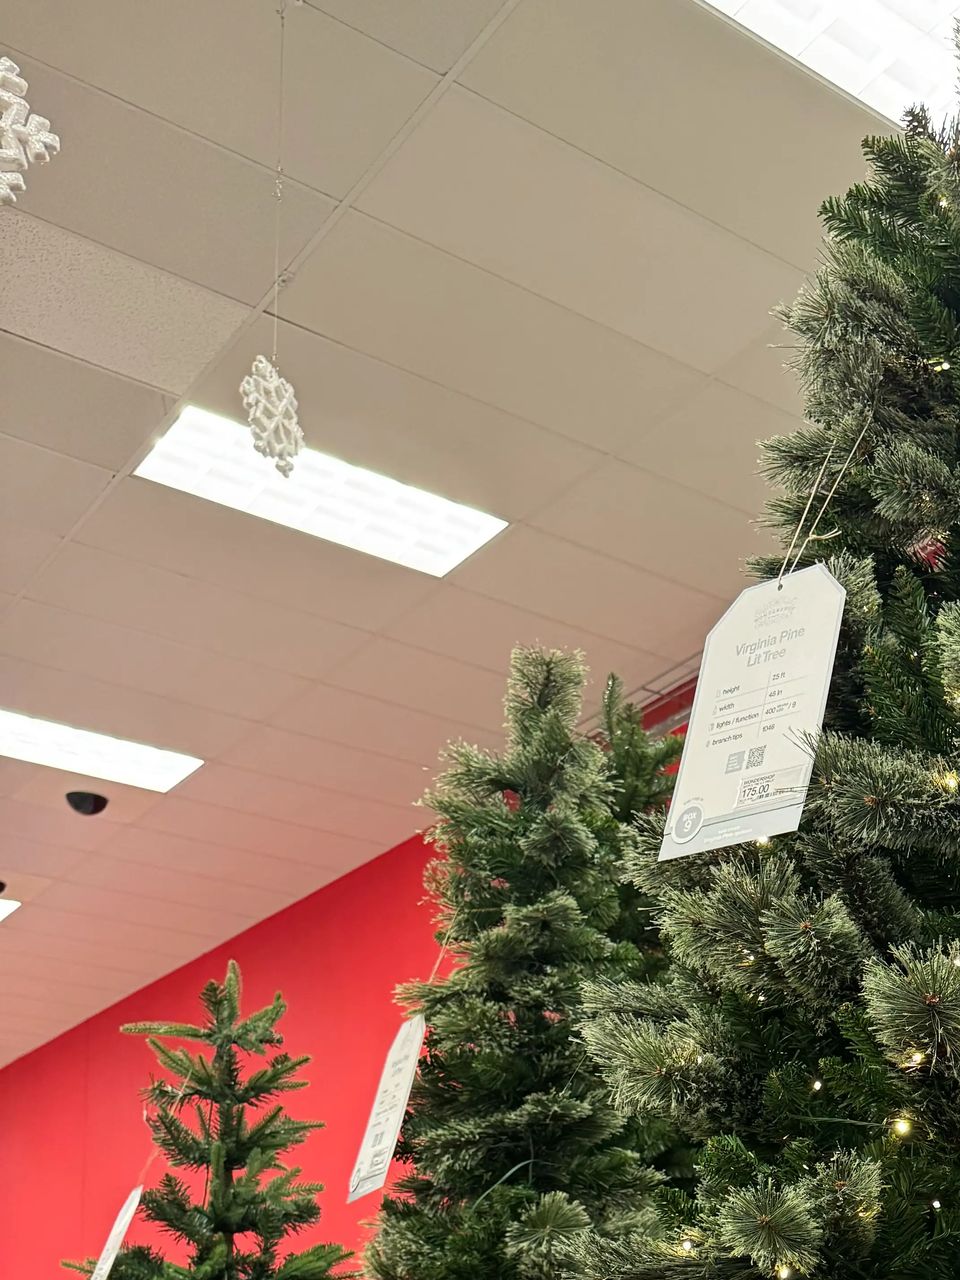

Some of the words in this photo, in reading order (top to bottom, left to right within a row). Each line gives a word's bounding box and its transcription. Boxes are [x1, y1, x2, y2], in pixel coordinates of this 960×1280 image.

[736, 635, 777, 656] Virginia
[779, 627, 805, 643] Pine
[746, 653, 761, 667] Lit
[763, 648, 786, 662] Tree
[722, 685, 740, 695] height
[719, 703, 735, 712] width
[716, 718, 731, 729] lights
[735, 712, 760, 724] function
[712, 735, 732, 746] branch
[732, 733, 743, 742] tips
[742, 784, 770, 799] 175.00
[683, 819, 692, 832] 9
